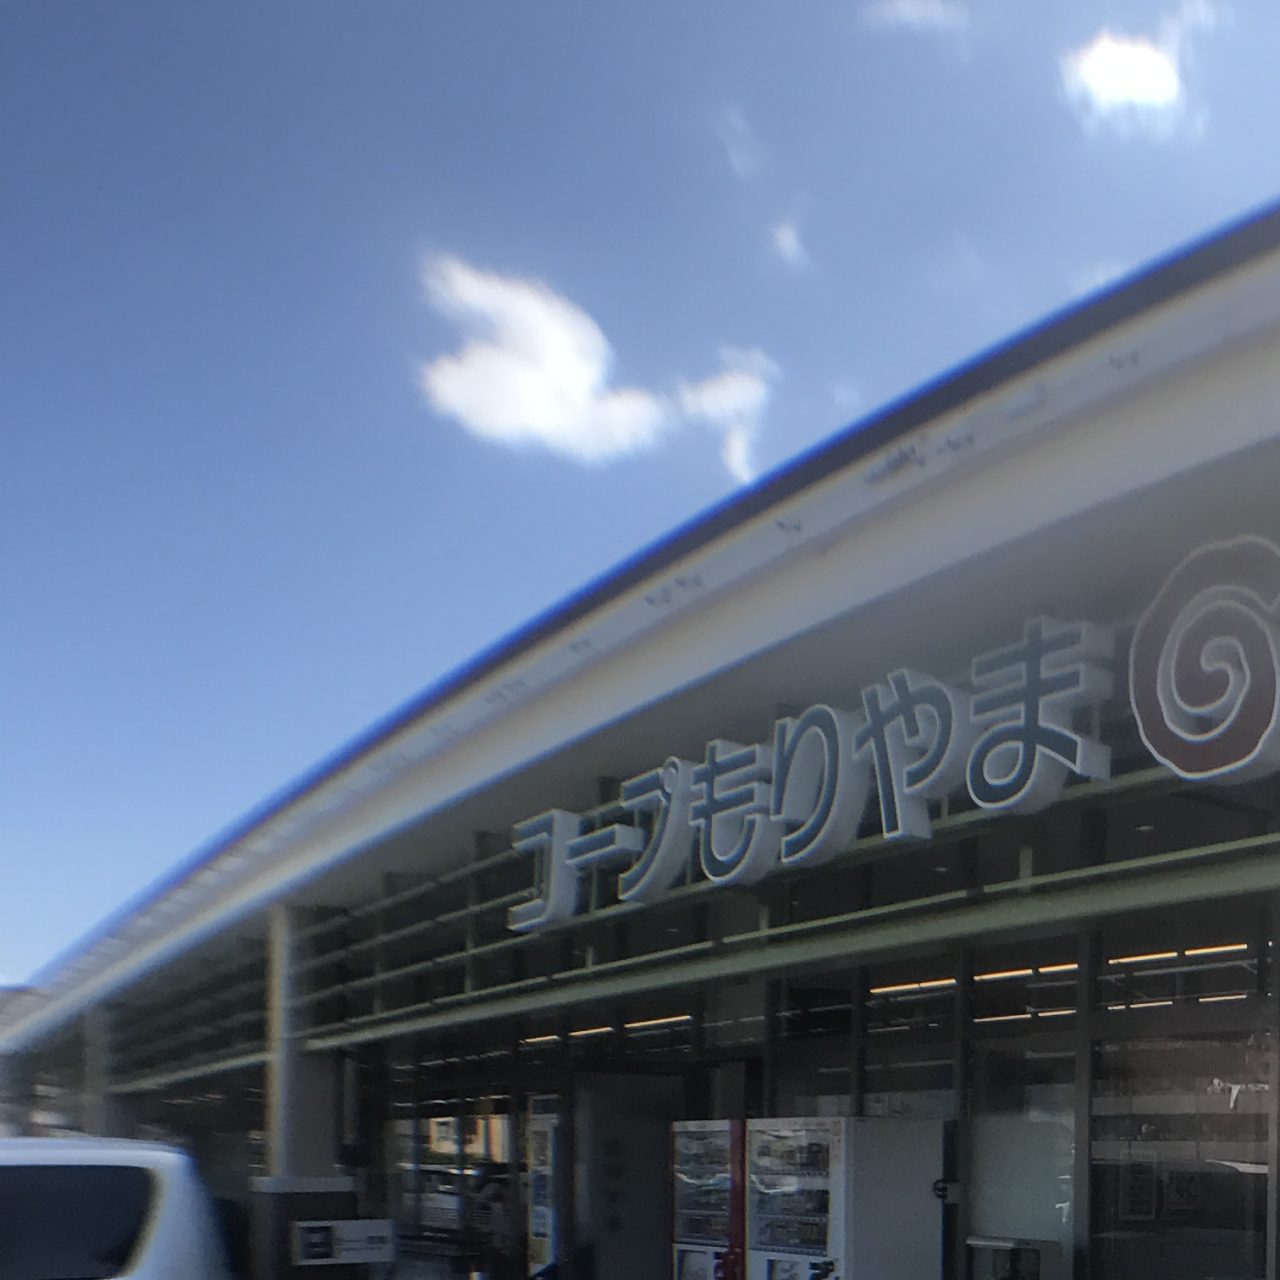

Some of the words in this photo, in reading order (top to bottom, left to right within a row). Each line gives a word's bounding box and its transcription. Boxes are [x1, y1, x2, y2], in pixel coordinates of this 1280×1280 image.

[508, 616, 1106, 933] コープもりやま
